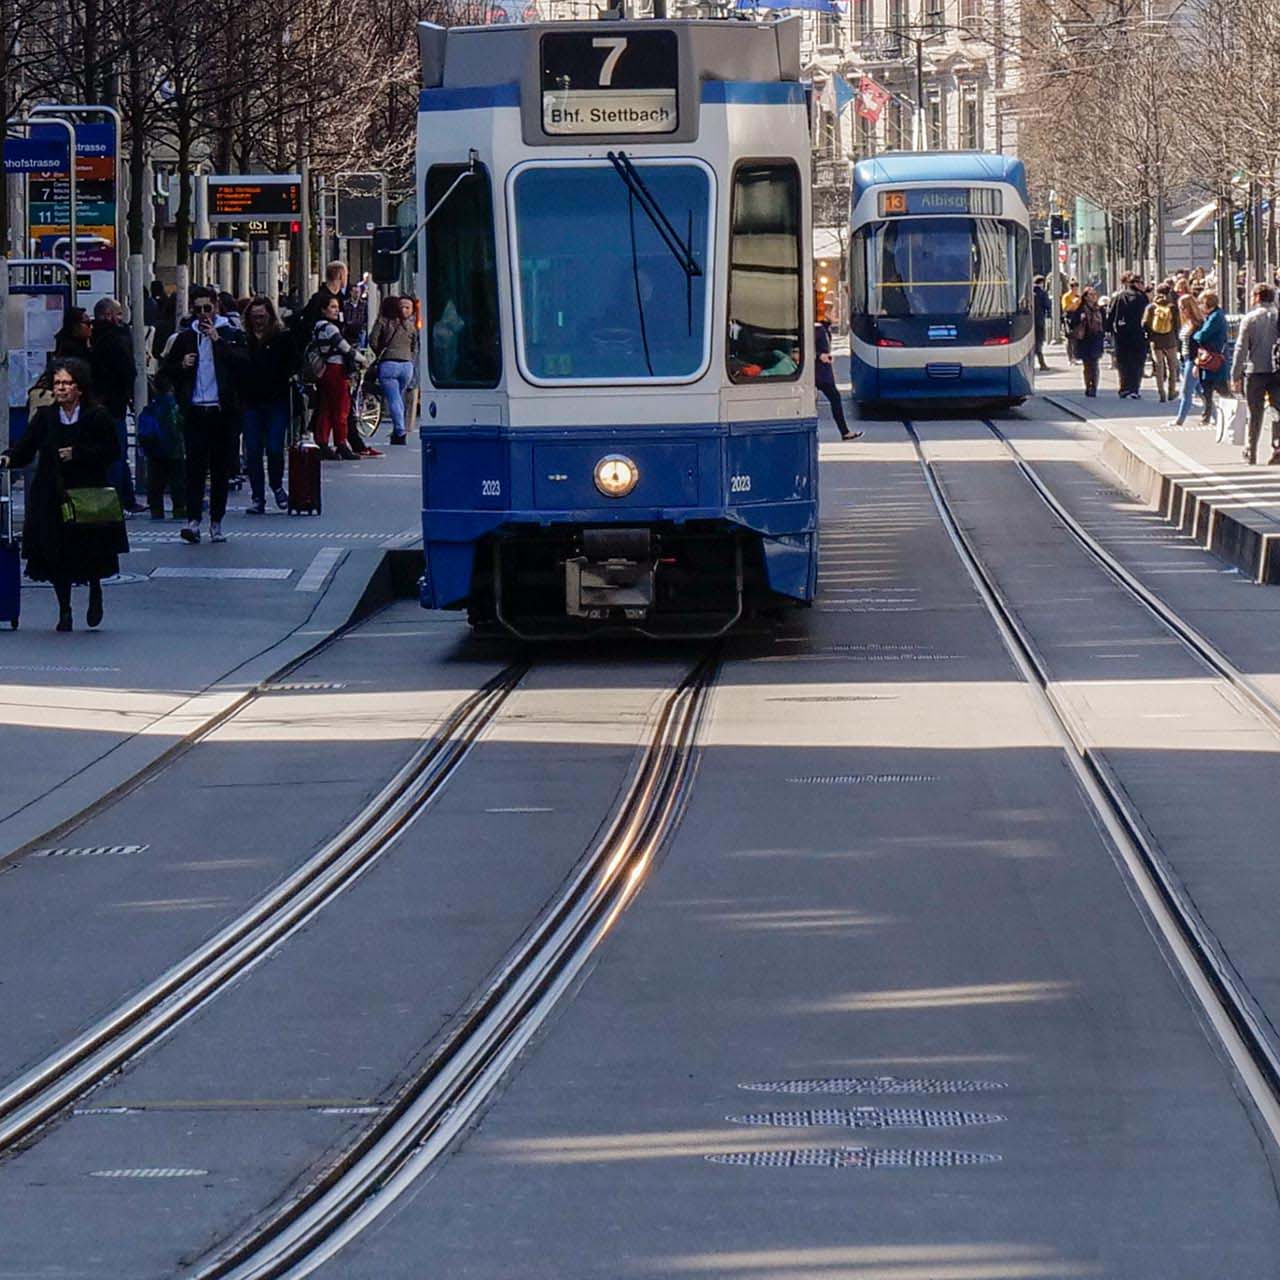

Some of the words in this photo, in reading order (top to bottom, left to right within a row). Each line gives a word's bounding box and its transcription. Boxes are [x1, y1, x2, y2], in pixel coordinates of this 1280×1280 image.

[592, 37, 628, 86] 7
[551, 108, 584, 123] Bhf.
[590, 107, 669, 122] Stettbach
[41, 188, 51, 201] 7
[886, 195, 904, 210] 13
[38, 210, 52, 224] 11
[482, 480, 502, 496] 2023
[731, 475, 752, 492] 2023
